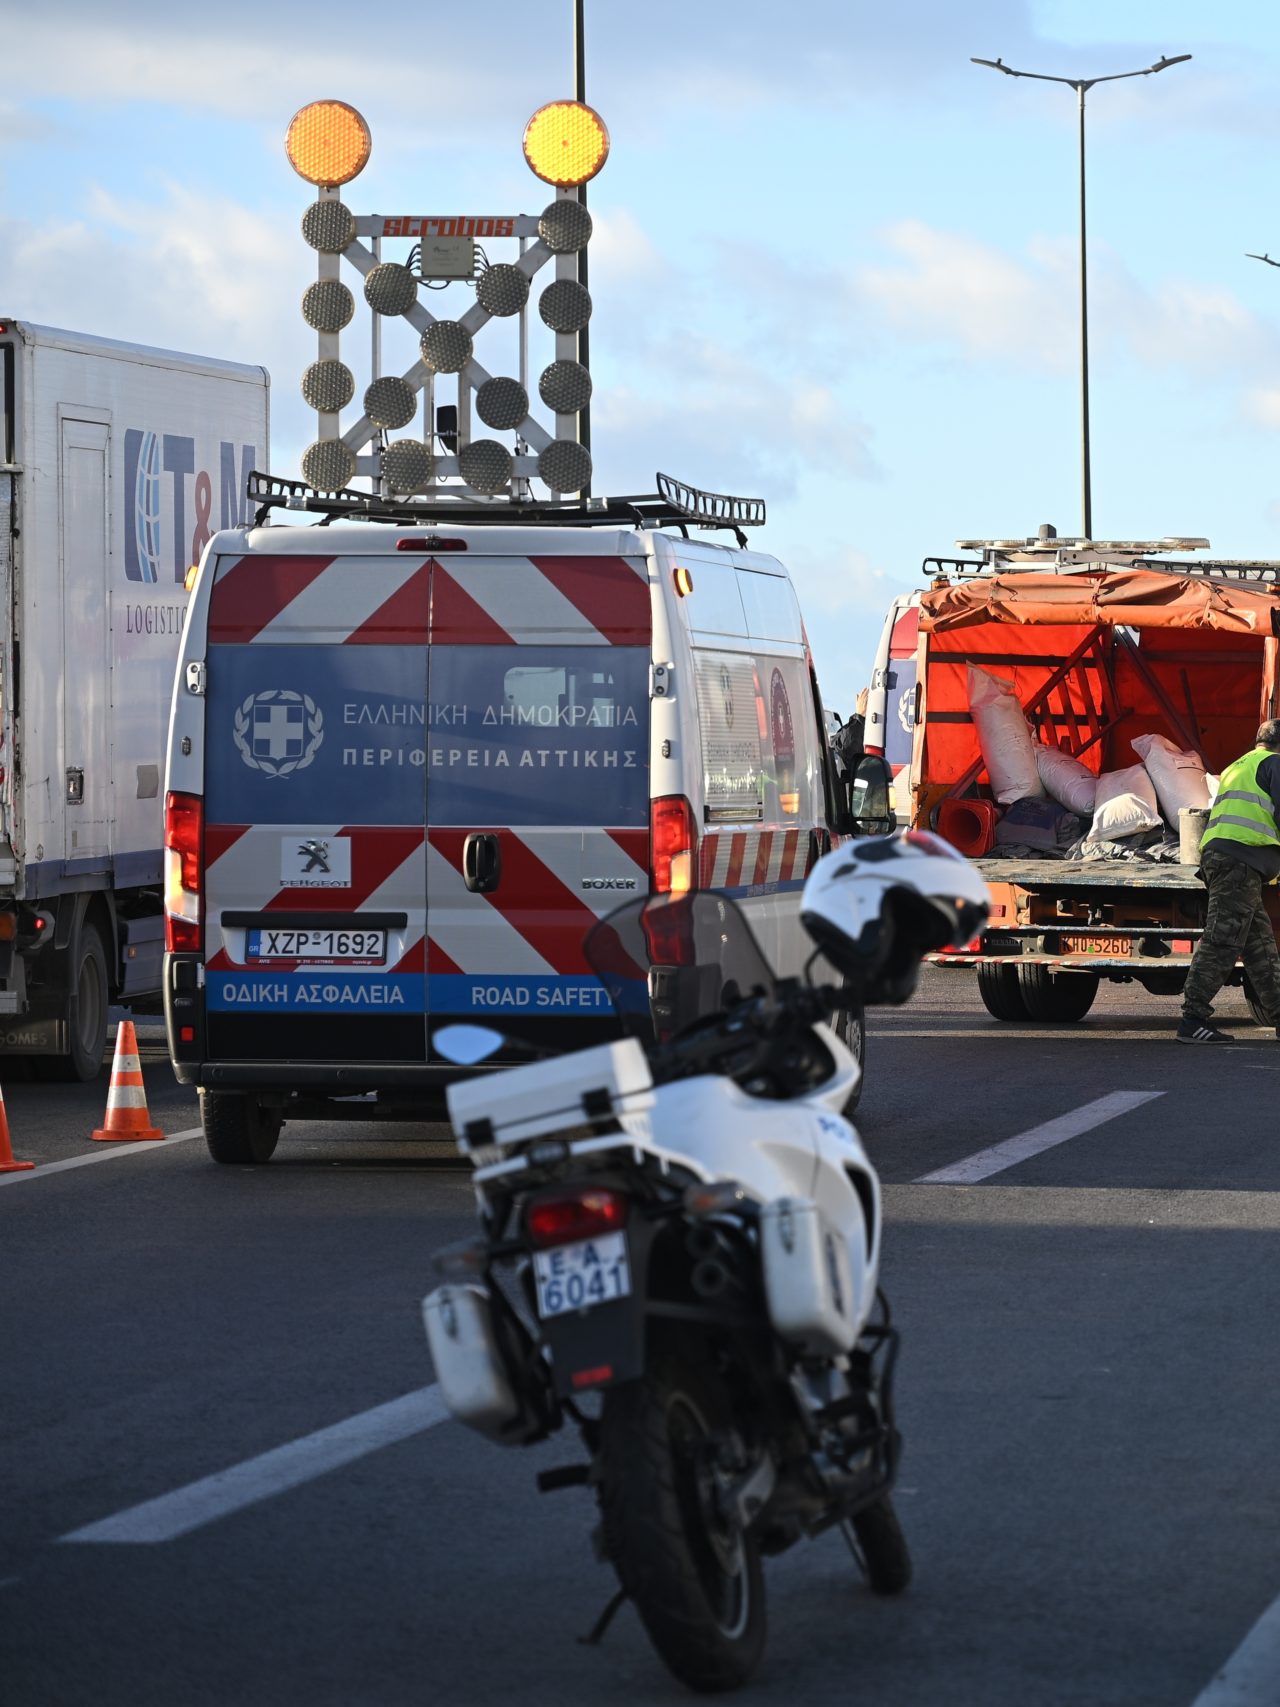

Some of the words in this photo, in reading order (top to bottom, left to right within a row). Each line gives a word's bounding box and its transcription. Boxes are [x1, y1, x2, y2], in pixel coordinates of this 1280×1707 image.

[382, 216, 515, 237] strobos
[126, 604, 188, 634] LOGISTIC
[343, 703, 467, 725] ΕΛΛΗΝΙΚΗ
[482, 704, 638, 727] ΔΗΜΟΚΡΑΤΙΑ
[343, 748, 510, 767] ΠΕΡΙΦΕΡΕΙΑ
[519, 750, 637, 768] ΑΤΤΙΚΗΣ
[582, 878, 637, 889] BOXER
[223, 984, 287, 1002] ΟΔΙΚΗ
[295, 985, 404, 1004] ΑΣΦΑΛΕΙΑ
[472, 987, 529, 1006] ROAD
[536, 988, 622, 1007] SAFETY
[545, 1265, 622, 1311] 6041
